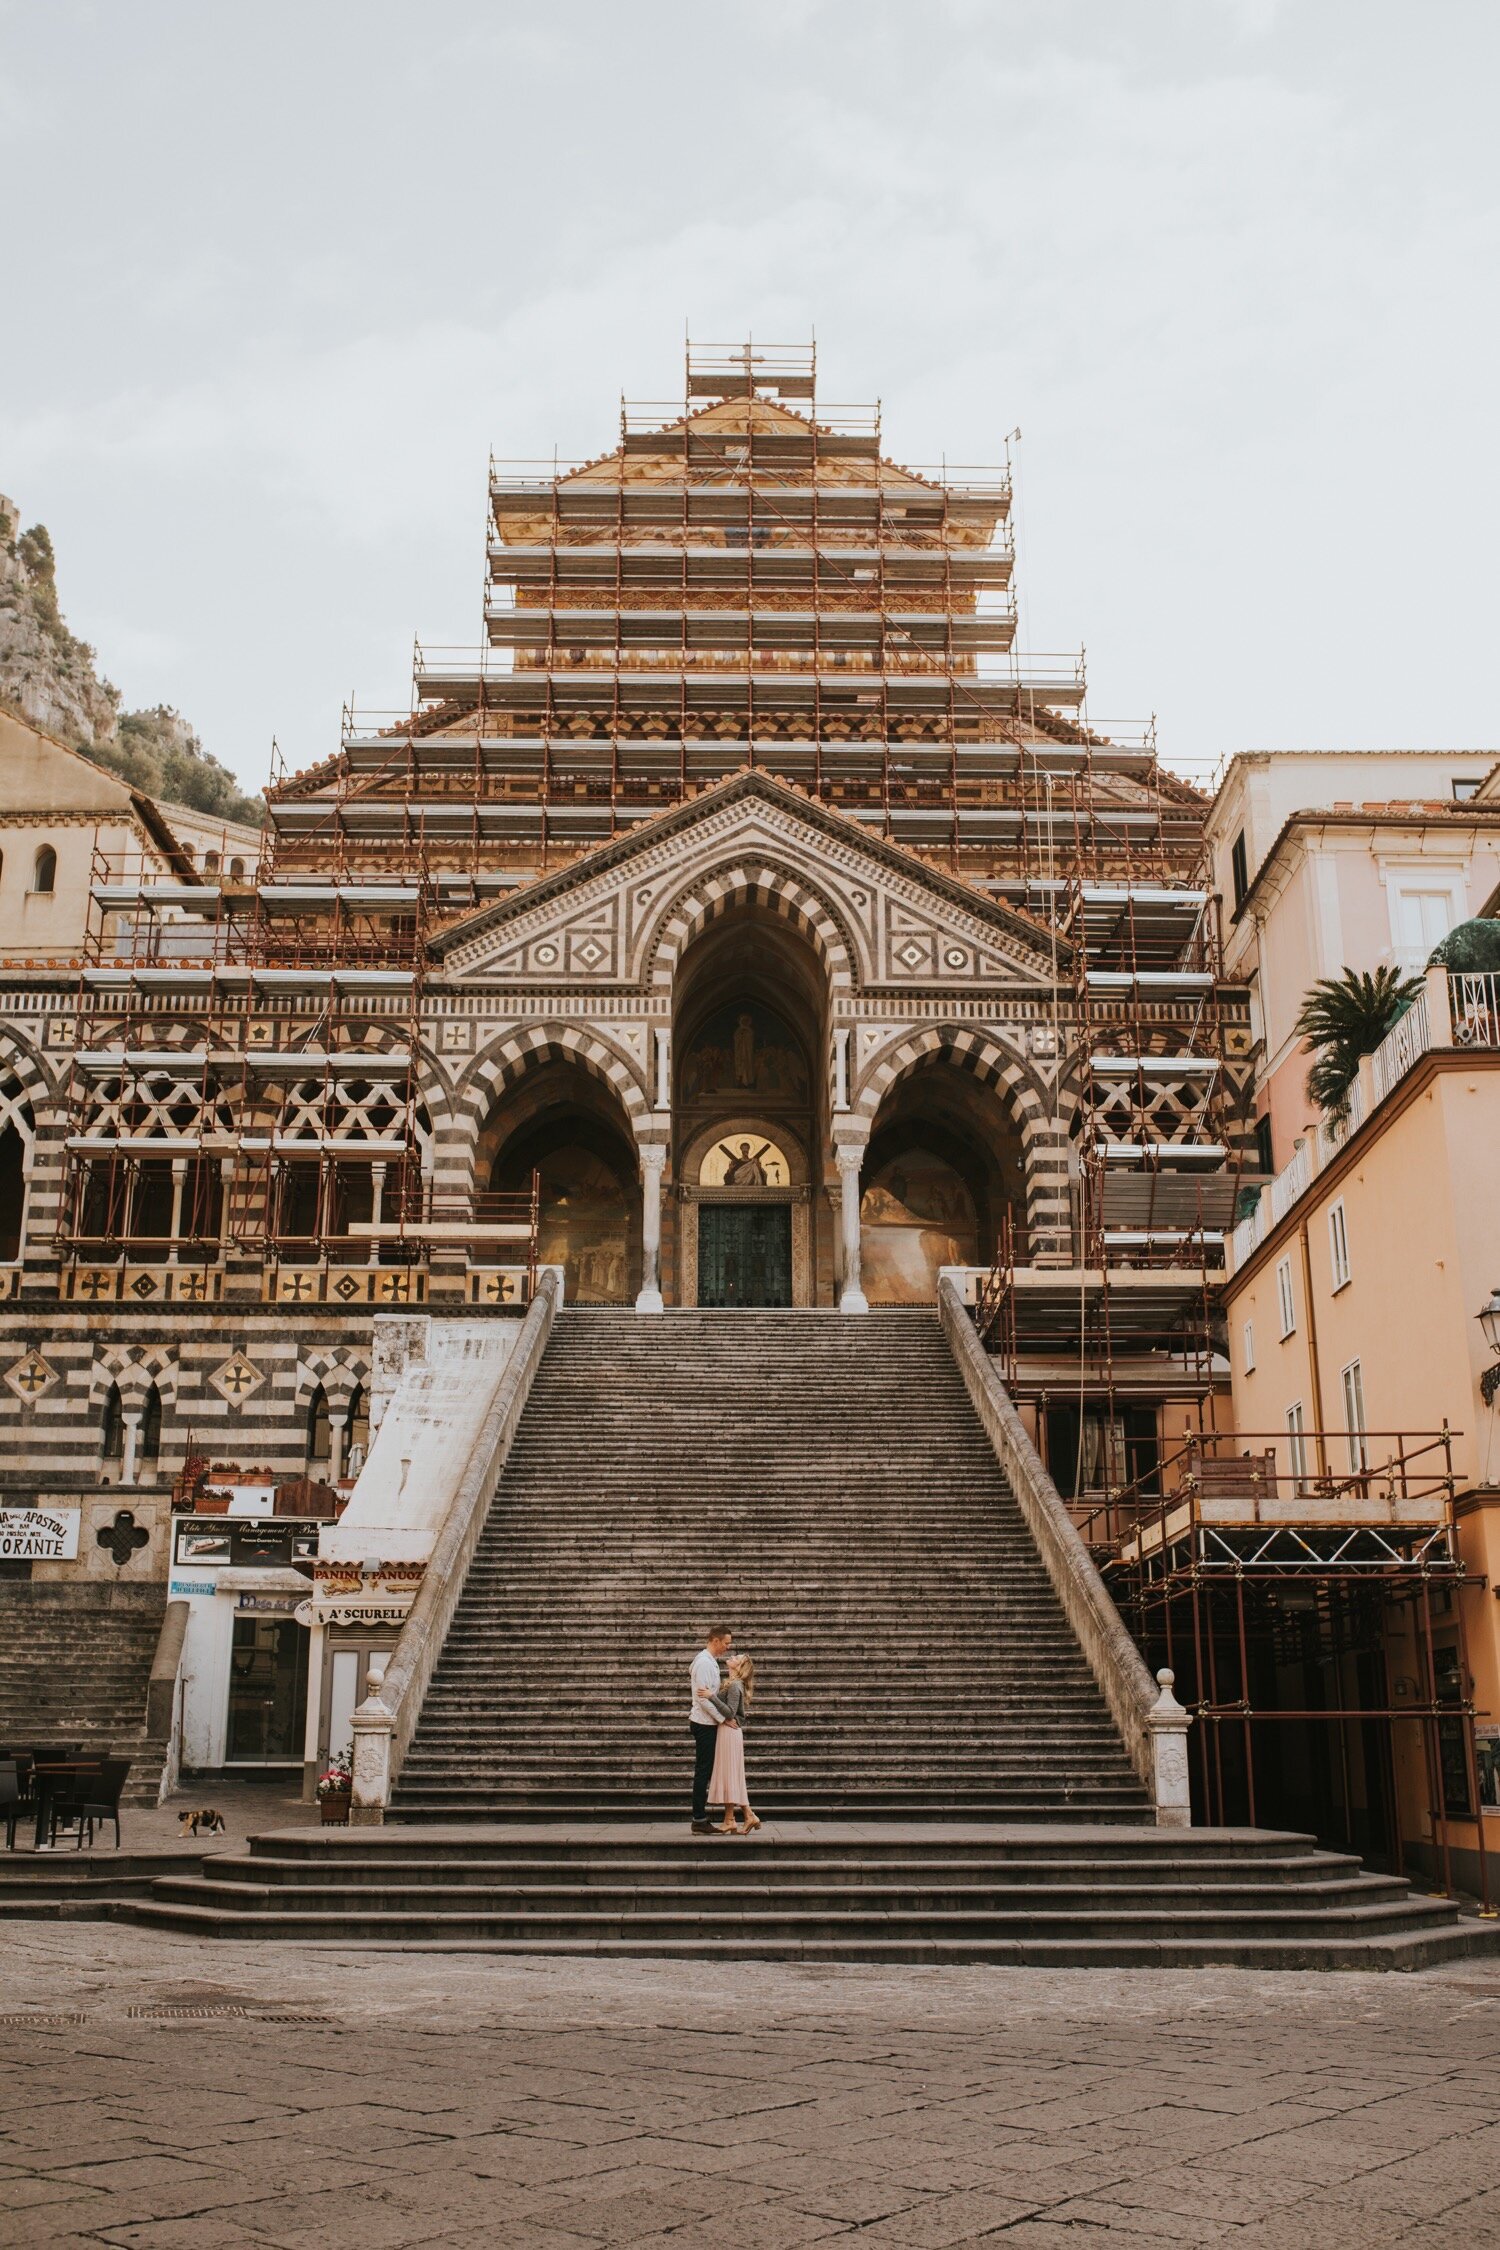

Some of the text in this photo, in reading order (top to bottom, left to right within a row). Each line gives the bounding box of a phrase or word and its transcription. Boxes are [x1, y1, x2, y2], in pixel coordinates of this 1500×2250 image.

[24, 1511, 67, 1538] APOSTOLI
[239, 1522, 288, 1536] Management
[0, 1538, 64, 1556] ORANTE
[315, 1570, 359, 1580] PANINI
[361, 1571, 369, 1580] E
[329, 1609, 341, 1619] A'
